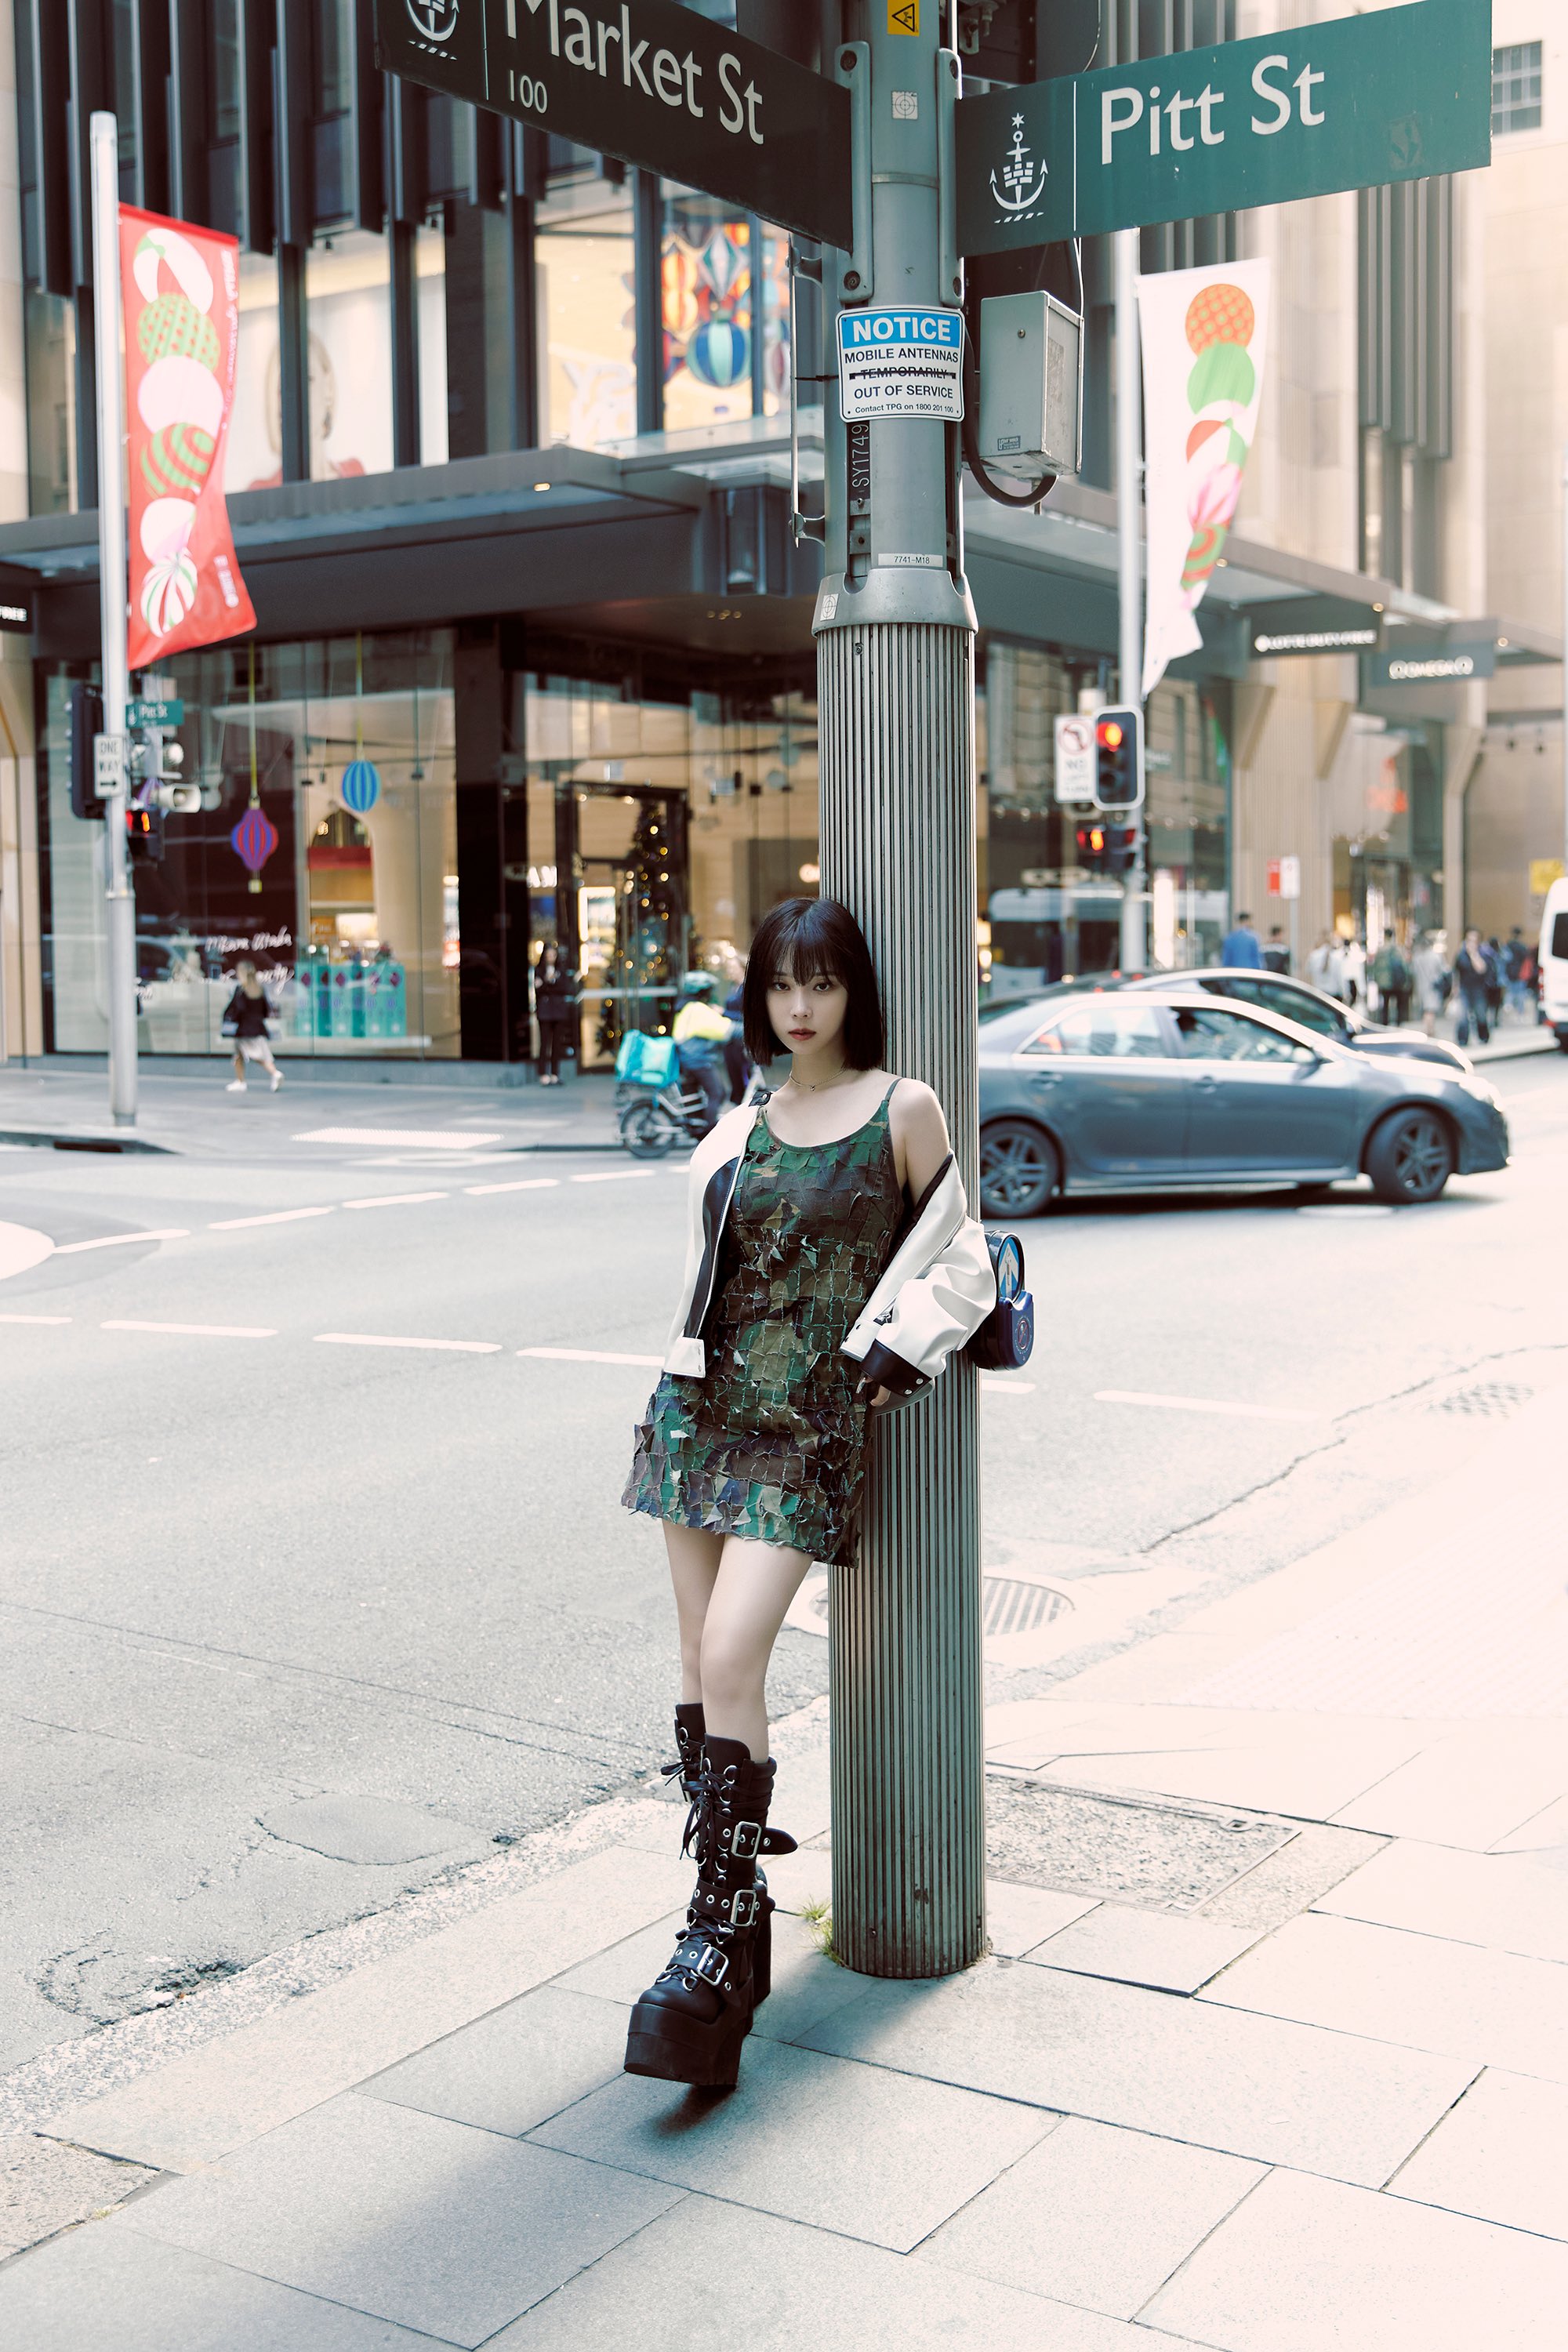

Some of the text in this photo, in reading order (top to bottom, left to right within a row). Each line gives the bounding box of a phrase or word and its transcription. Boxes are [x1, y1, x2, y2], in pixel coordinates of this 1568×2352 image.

[509, 69, 548, 114] 100
[719, 53, 764, 145] St
[1101, 55, 1325, 165] Pitt St
[853, 317, 951, 343] NOTICE
[844, 348, 959, 364] MOBILE ANTENNAS
[860, 366, 947, 380] TEMPORARILY
[854, 384, 953, 399] OUT OF SERVICE
[855, 404, 884, 413] Contact
[851, 424, 869, 488] SY1749
[894, 556, 930, 564] 7741-M18
